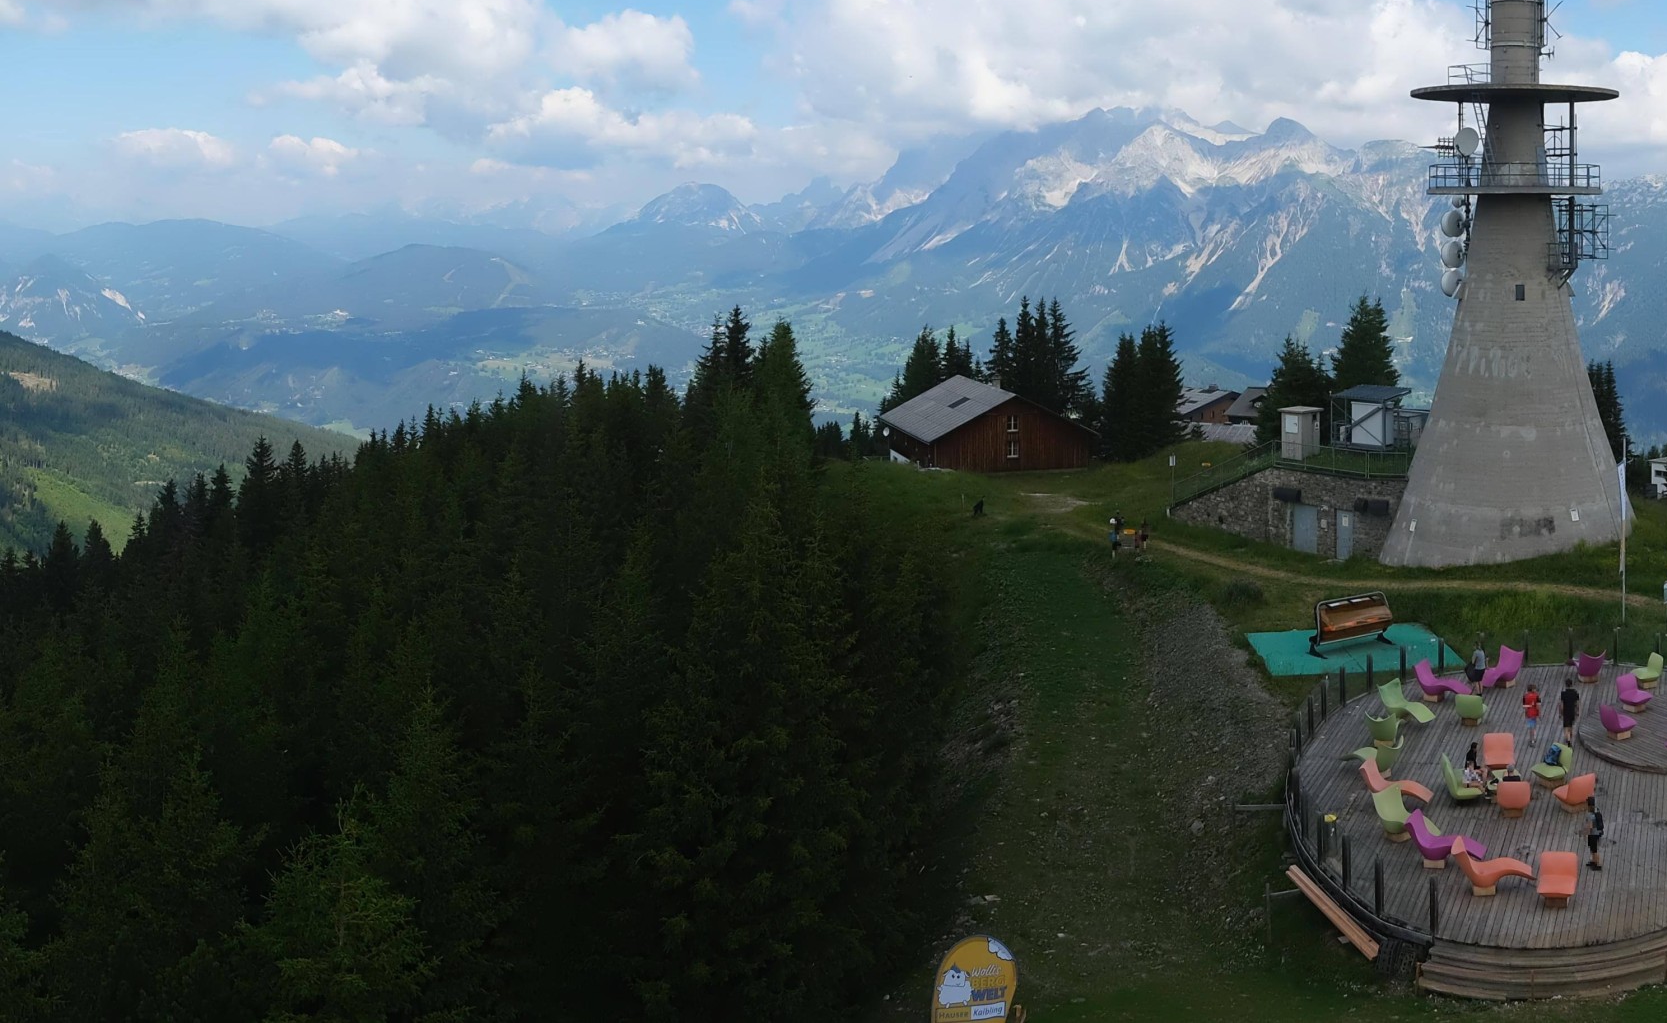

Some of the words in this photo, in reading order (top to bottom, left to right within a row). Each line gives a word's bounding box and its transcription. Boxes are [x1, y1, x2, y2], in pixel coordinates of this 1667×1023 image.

[971, 975, 1006, 988] BERG
[971, 986, 1007, 1002] WELT
[973, 1006, 1003, 1017] Kaibling
